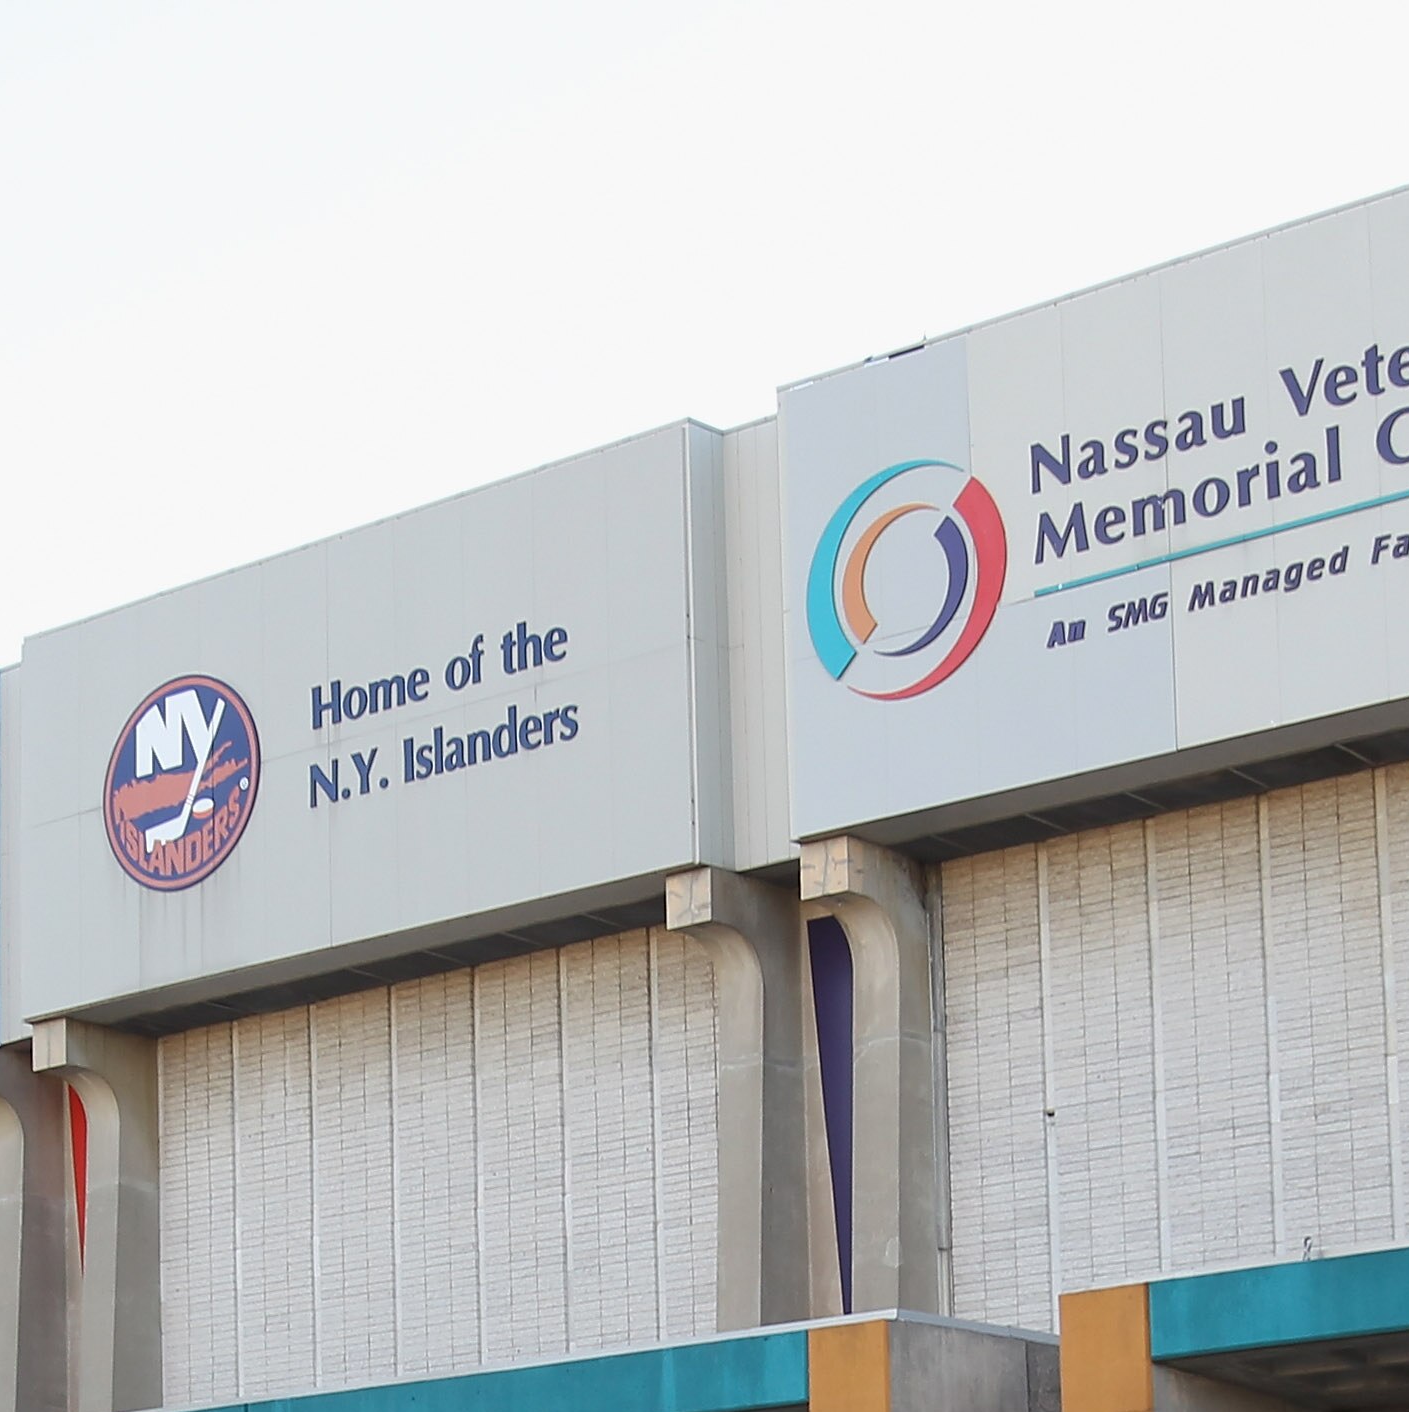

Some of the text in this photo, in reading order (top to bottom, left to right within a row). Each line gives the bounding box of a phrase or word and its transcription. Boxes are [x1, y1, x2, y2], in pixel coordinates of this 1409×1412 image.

[1030, 396, 1246, 494] Nassau
[1035, 425, 1342, 564] Memorial
[1046, 619, 1087, 649] An
[1107, 591, 1169, 633] SMG
[1187, 545, 1350, 612] Managed
[310, 621, 568, 730] Home of the
[136, 689, 226, 778] NY
[309, 704, 579, 808] N.Y. Islanders
[117, 785, 241, 877] ISLANDERS
